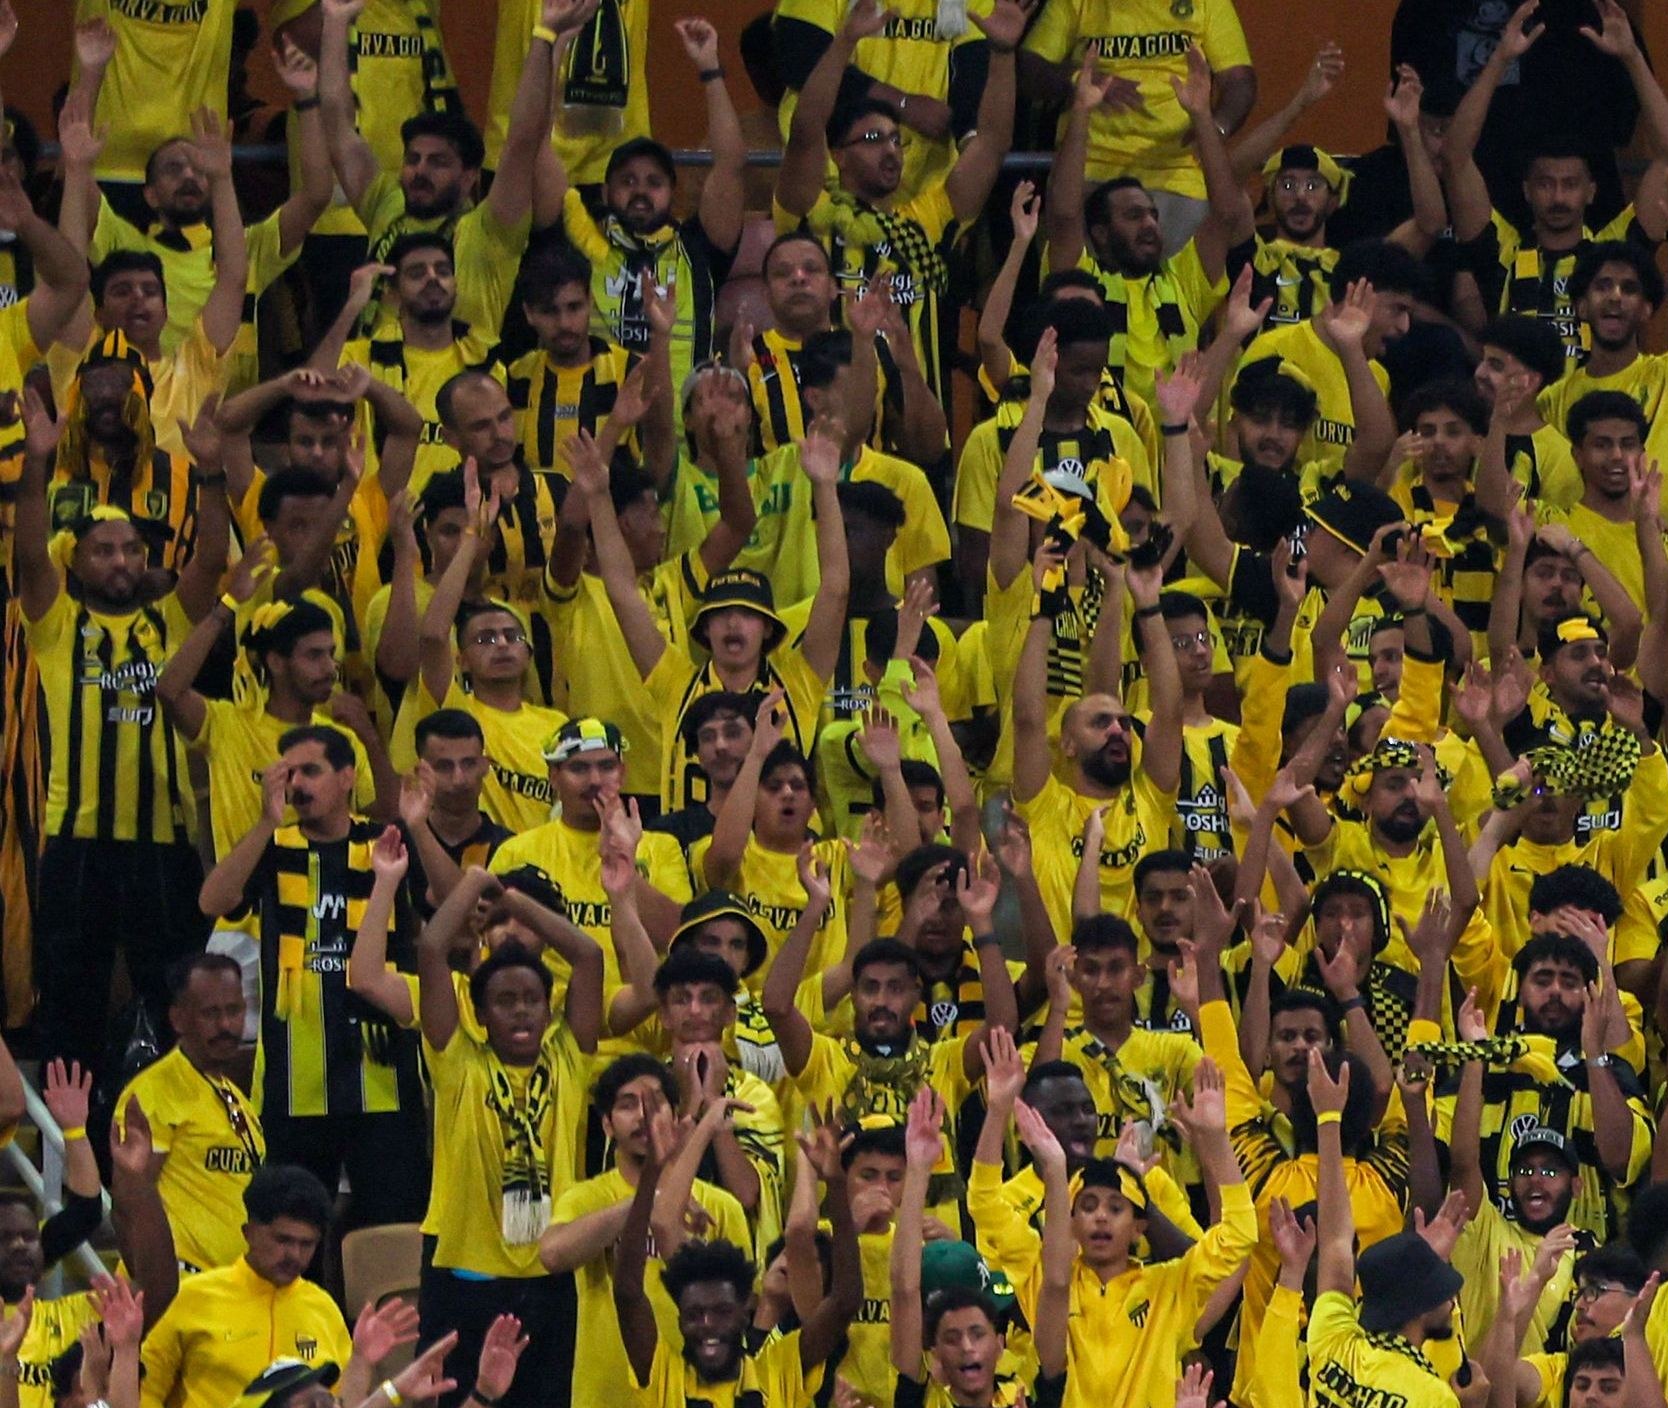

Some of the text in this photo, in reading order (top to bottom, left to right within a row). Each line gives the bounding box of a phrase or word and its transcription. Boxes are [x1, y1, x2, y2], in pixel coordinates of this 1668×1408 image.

[911, 20, 936, 39] GO
[361, 34, 422, 55] RVA GO
[1316, 420, 1353, 446] URVA
[841, 698, 872, 712] ROS
[524, 779, 553, 806] GOL
[1182, 812, 1230, 833] OSH
[313, 957, 346, 972] ROS
[207, 1148, 251, 1173] CUR
